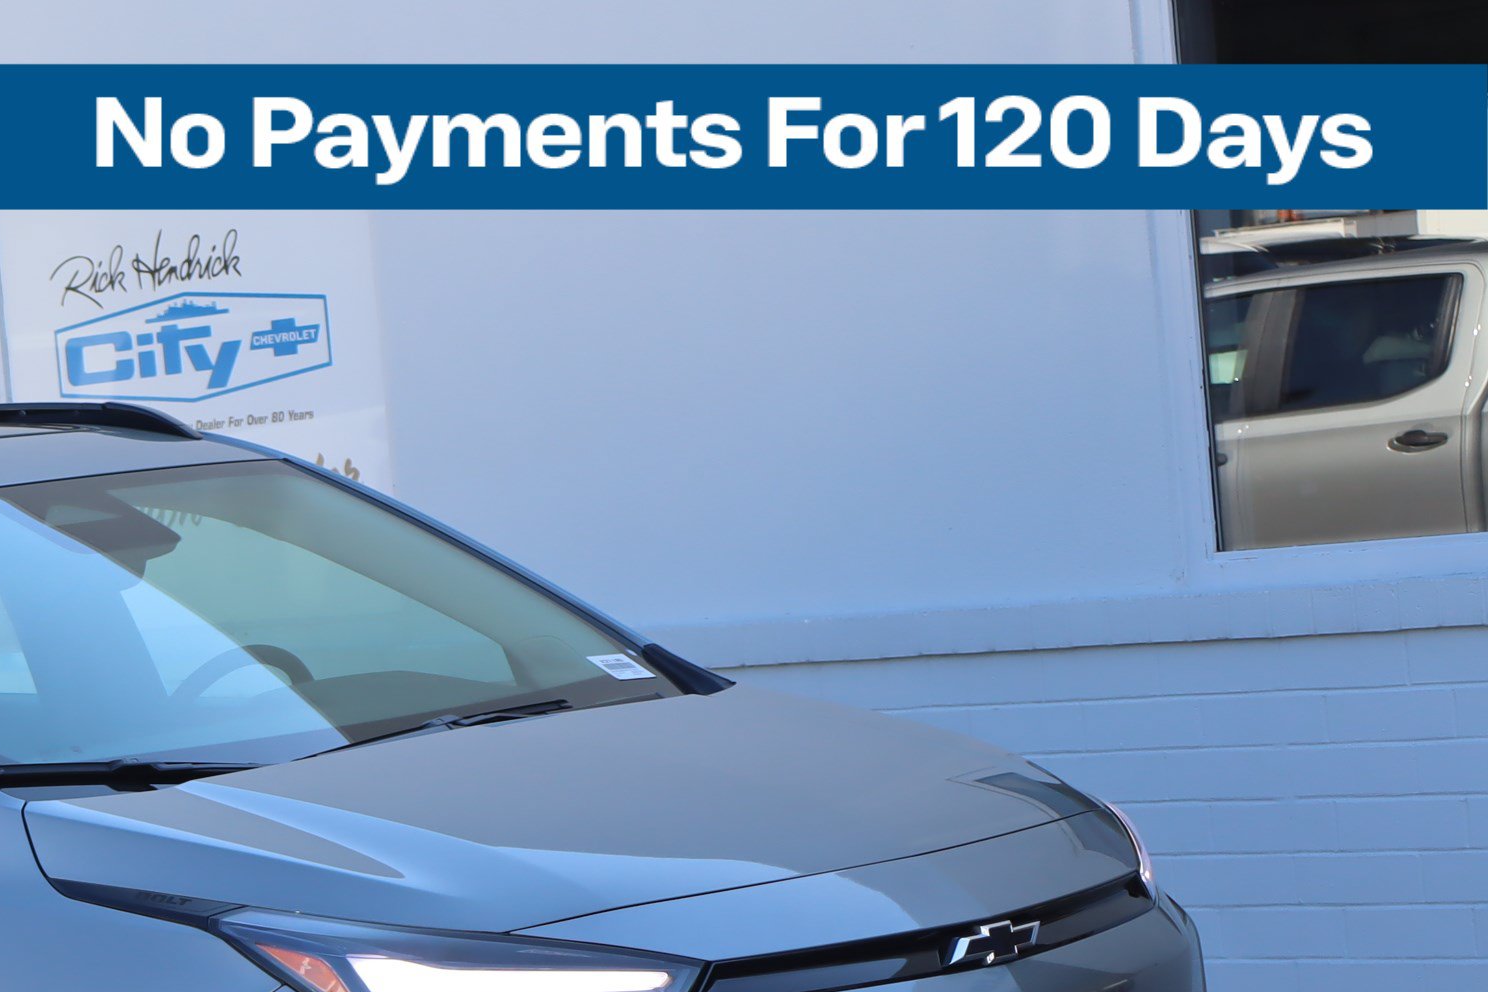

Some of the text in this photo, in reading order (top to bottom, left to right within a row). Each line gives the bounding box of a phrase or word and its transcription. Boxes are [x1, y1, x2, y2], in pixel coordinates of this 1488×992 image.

[50, 229, 243, 309] Rick Hendrick
[65, 324, 243, 390] City
[253, 328, 317, 346] CHEVROLET
[196, 418, 225, 430] Dealer
[228, 416, 244, 427] For
[247, 414, 269, 426] Over
[271, 411, 285, 423] 80
[288, 409, 315, 421] Years
